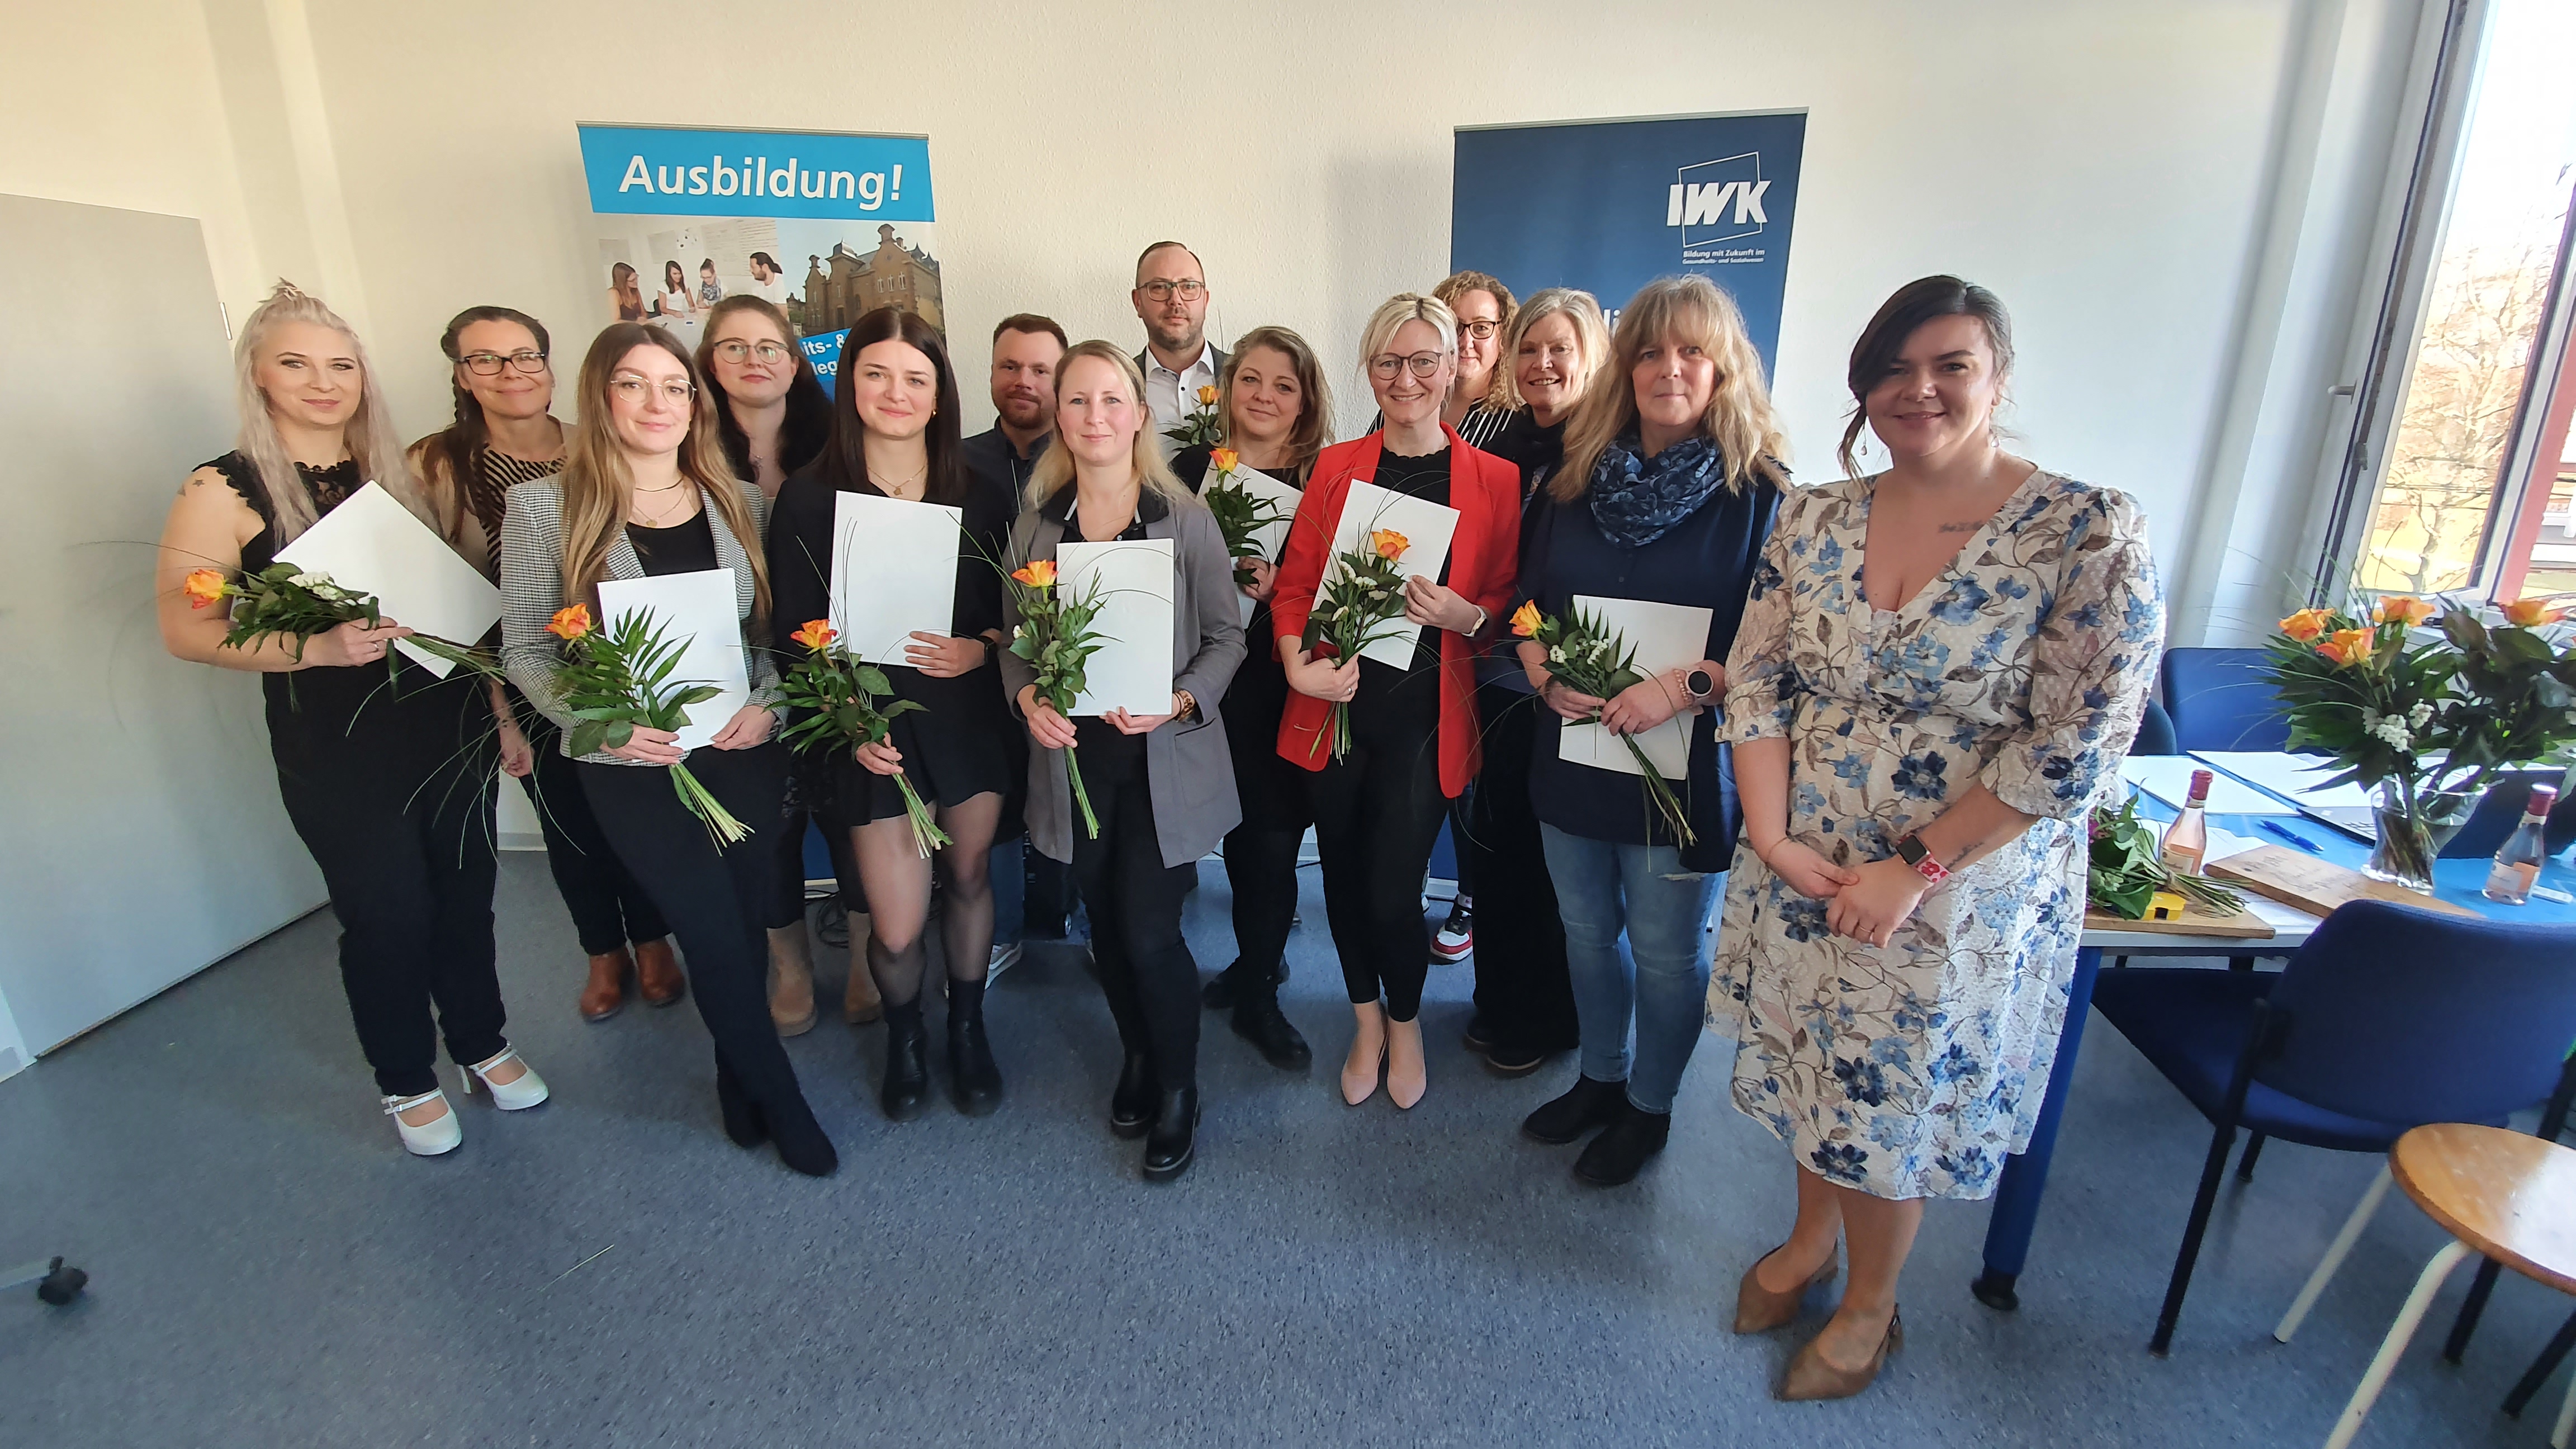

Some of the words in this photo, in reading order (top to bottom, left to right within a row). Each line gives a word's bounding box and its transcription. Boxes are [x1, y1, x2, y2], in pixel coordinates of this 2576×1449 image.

[618, 155, 903, 211] Ausbildung!
[1666, 181, 1772, 226] IWK
[1683, 250, 1710, 258] Bildung
[801, 340, 832, 356] its-
